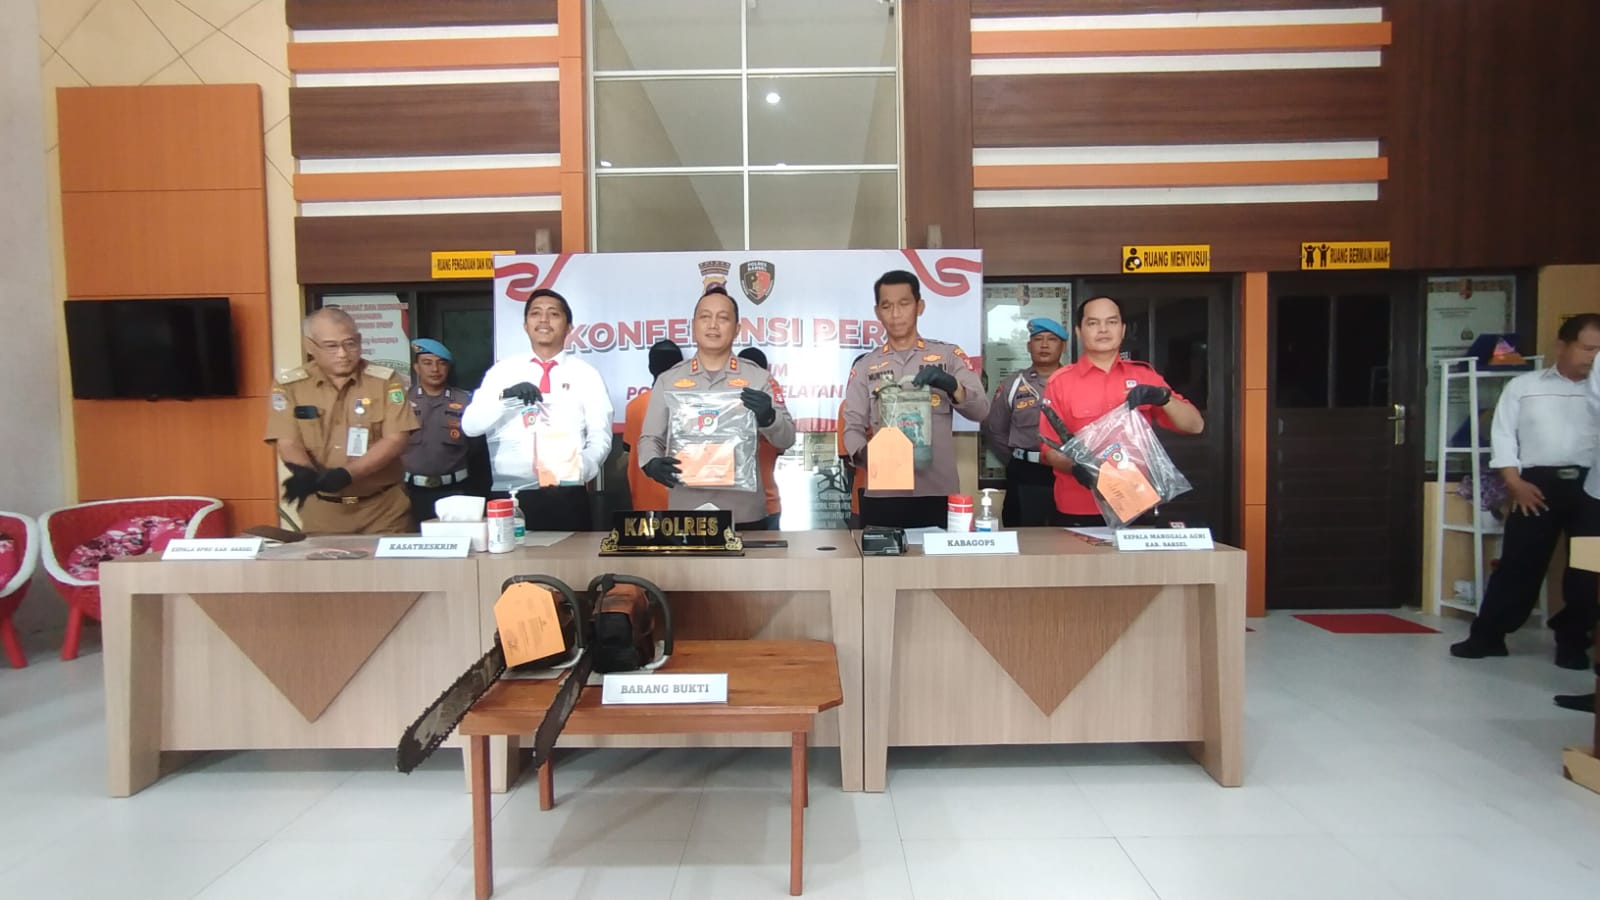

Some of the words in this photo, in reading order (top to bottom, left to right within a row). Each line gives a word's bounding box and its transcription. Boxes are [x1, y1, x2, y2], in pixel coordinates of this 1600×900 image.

[1143, 251, 1169, 267] RUANG
[1170, 250, 1208, 267] MENYUSUI
[1330, 247, 1347, 264] RUANG
[1349, 247, 1372, 263] BERMAIN
[437, 258, 451, 271] RUANG
[564, 316, 802, 351] KONFENSI
[813, 317, 889, 347] PER
[782, 384, 844, 399] ELATAN
[624, 516, 719, 537] KAPOLRES
[388, 543, 458, 551] KASATRESKRIM
[947, 539, 996, 547] KABAGOPS
[620, 684, 669, 694] BARANG
[672, 683, 710, 693] BUKTI
